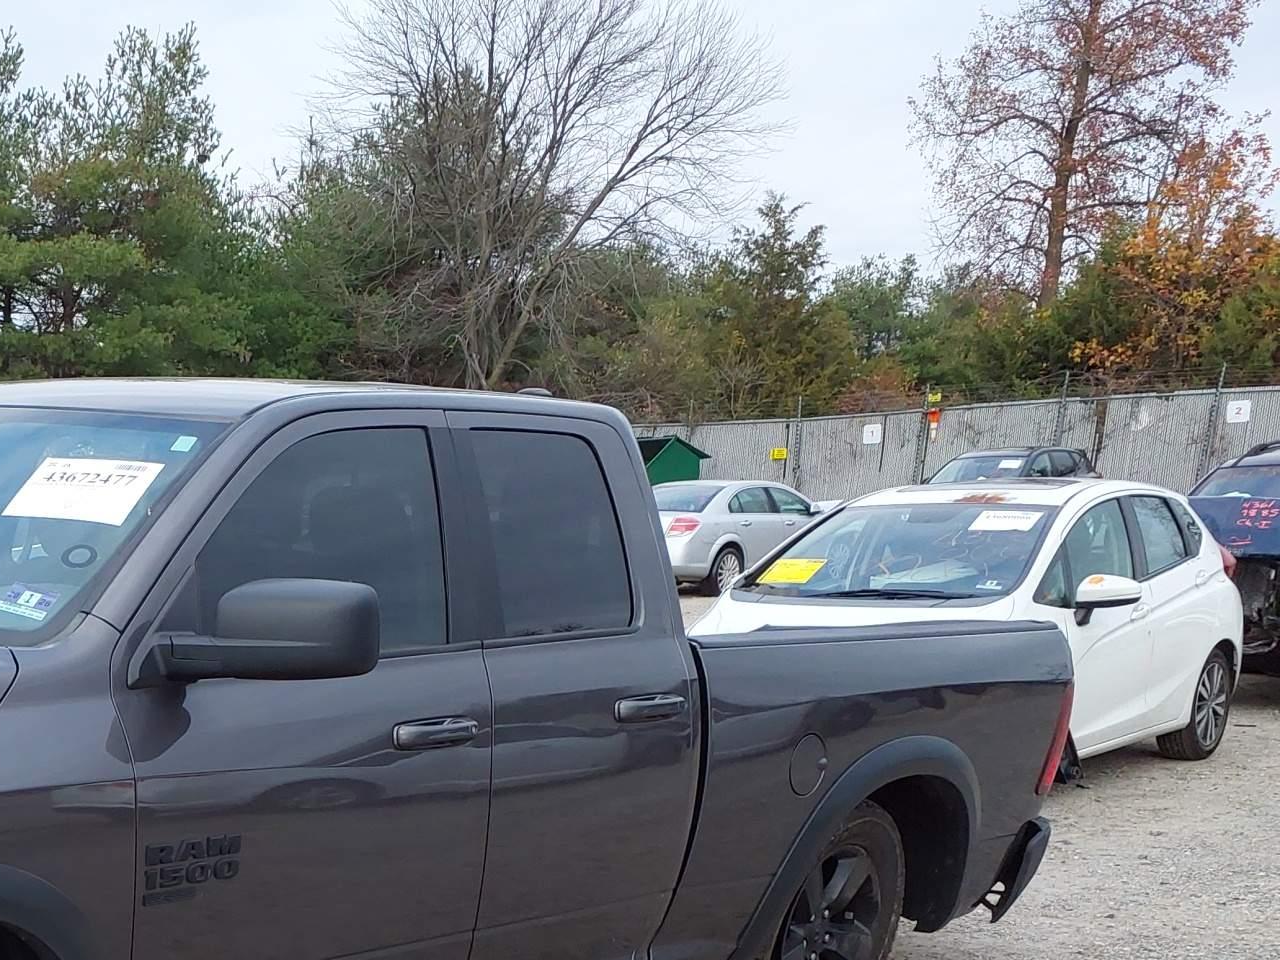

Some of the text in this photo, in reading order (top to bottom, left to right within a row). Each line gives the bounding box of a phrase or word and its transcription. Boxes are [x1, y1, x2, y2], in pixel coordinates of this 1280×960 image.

[1234, 406, 1242, 415] 2
[43, 471, 139, 487] 43672477
[144, 834, 241, 866] RAM
[143, 858, 240, 891] 1500
